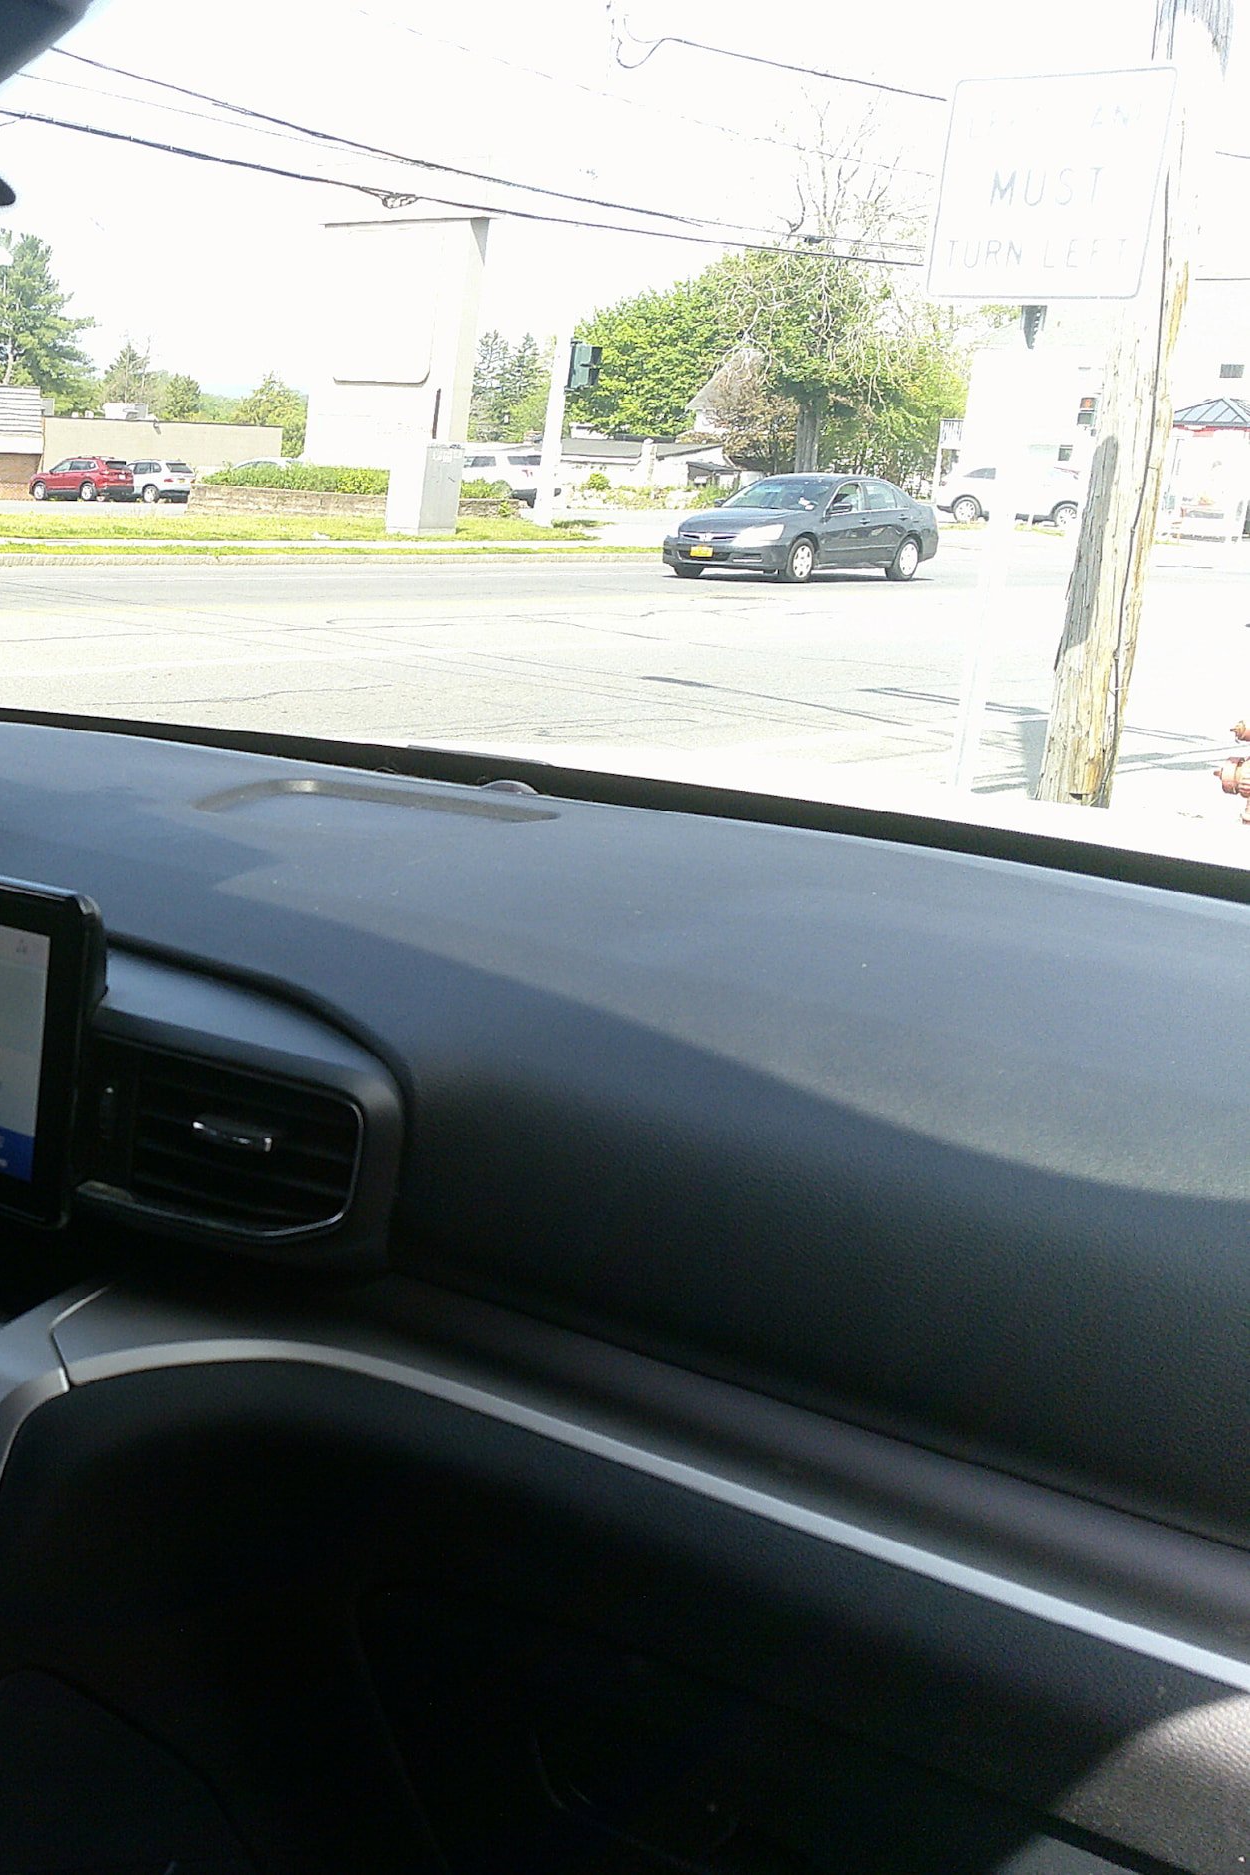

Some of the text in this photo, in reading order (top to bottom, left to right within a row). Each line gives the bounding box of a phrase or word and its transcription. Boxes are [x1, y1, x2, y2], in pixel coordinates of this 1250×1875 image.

[989, 166, 1105, 207] MUST
[948, 238, 1128, 269] TURN LEFT
